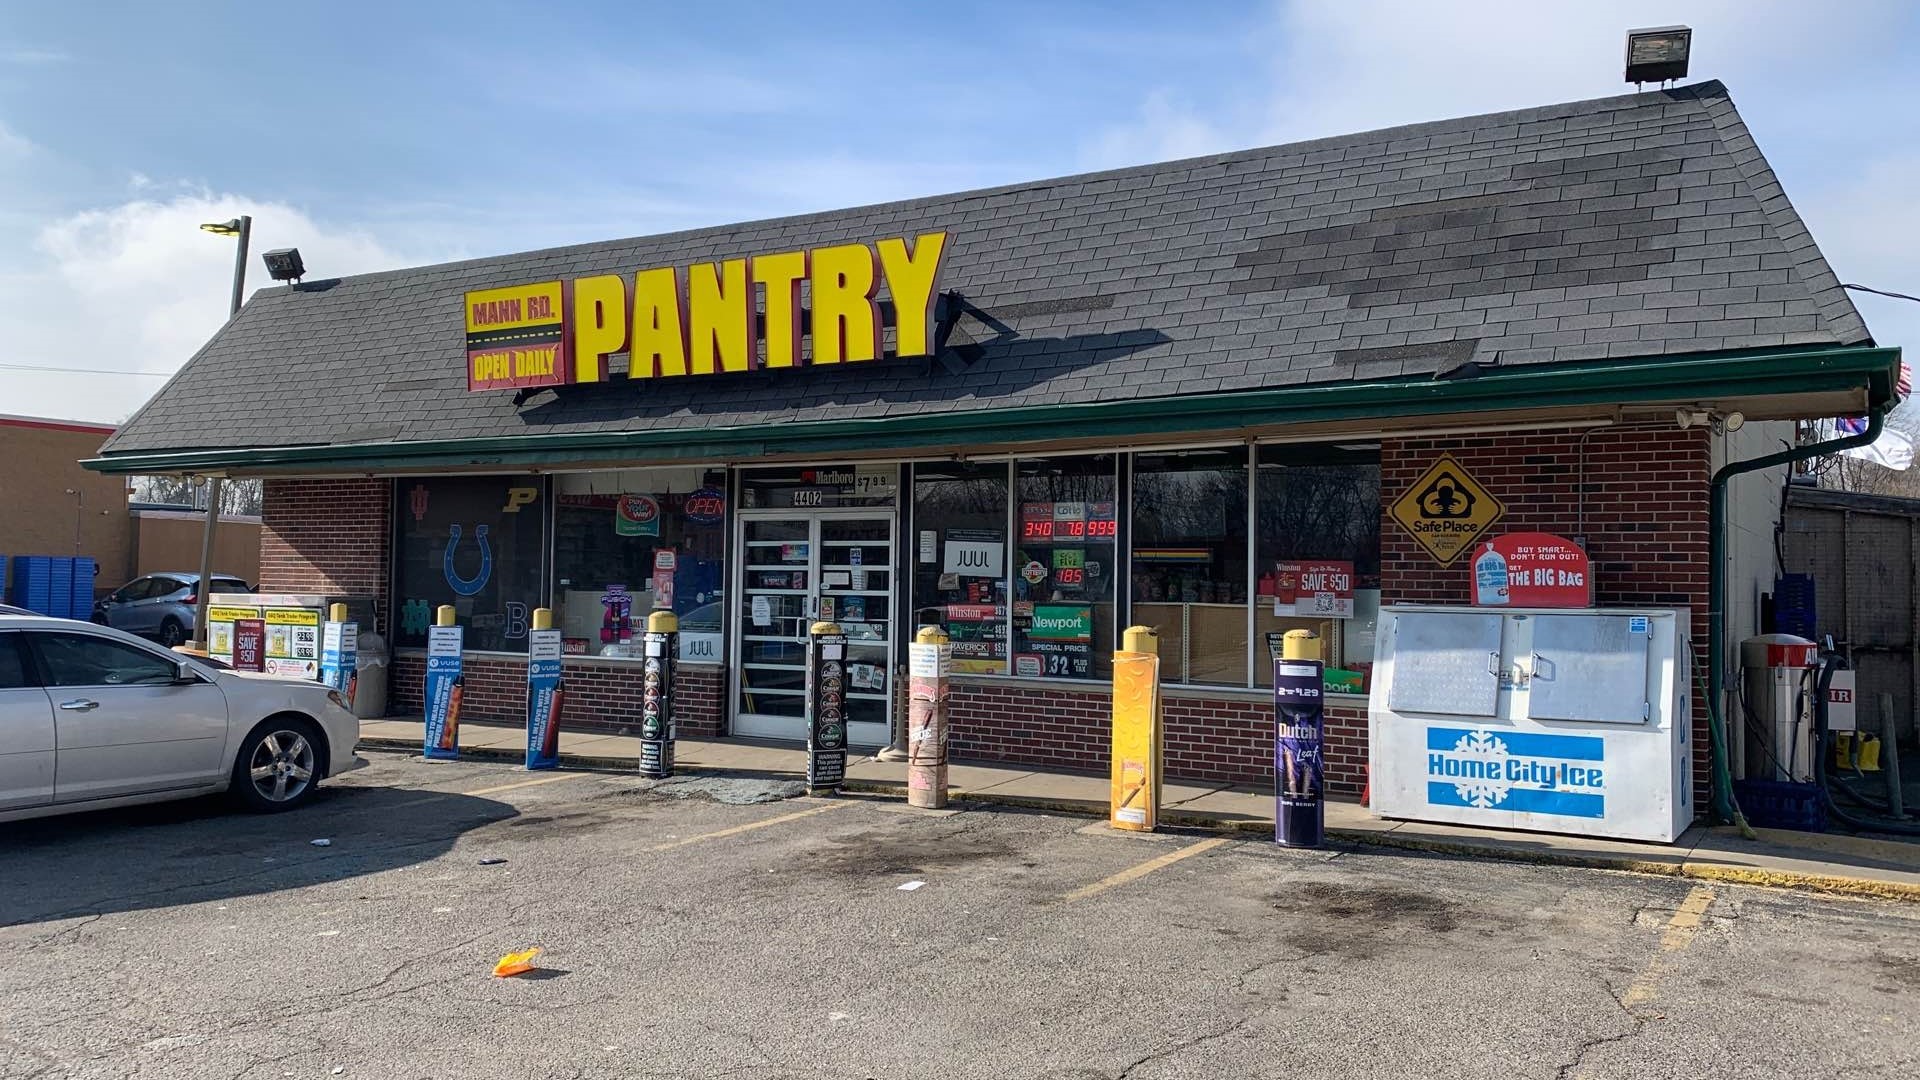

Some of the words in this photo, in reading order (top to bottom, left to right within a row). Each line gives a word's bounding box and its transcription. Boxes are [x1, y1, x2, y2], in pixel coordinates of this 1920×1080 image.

[473, 298, 521, 326] MANN
[527, 296, 556, 320] RD.
[573, 232, 949, 384] PANTRY
[474, 351, 509, 382] OPEN
[515, 346, 557, 377] DAILY
[815, 471, 854, 484] Marlboro
[503, 487, 538, 513] P
[794, 492, 821, 505] 4402
[685, 499, 725, 515] OPEN
[1024, 522, 1052, 536] 340
[957, 550, 990, 568] JUUL
[1276, 563, 1301, 572] Winston
[1301, 573, 1327, 591] SAVE
[1329, 574, 1349, 591] $50
[1508, 570, 1530, 586] THE
[1534, 568, 1554, 586] BIG
[1558, 570, 1584, 586] BAG
[948, 605, 981, 618] Winston
[505, 601, 528, 639] B
[1033, 615, 1082, 631] Newport
[238, 637, 257, 650] SAVE
[688, 640, 713, 657] JUUL
[952, 642, 987, 651] MAVERICK
[1031, 643, 1062, 652] SPECIAL
[1064, 644, 1088, 652] PRICE
[241, 650, 255, 663] $50
[1075, 665, 1086, 673] TAX
[1278, 687, 1286, 696] 2
[1829, 690, 1850, 702] IR
[1278, 722, 1318, 740] Dutch
[1296, 744, 1319, 763] Leaf
[1428, 753, 1500, 780] Home
[1505, 759, 1557, 789] City
[1561, 762, 1603, 788] Ice
